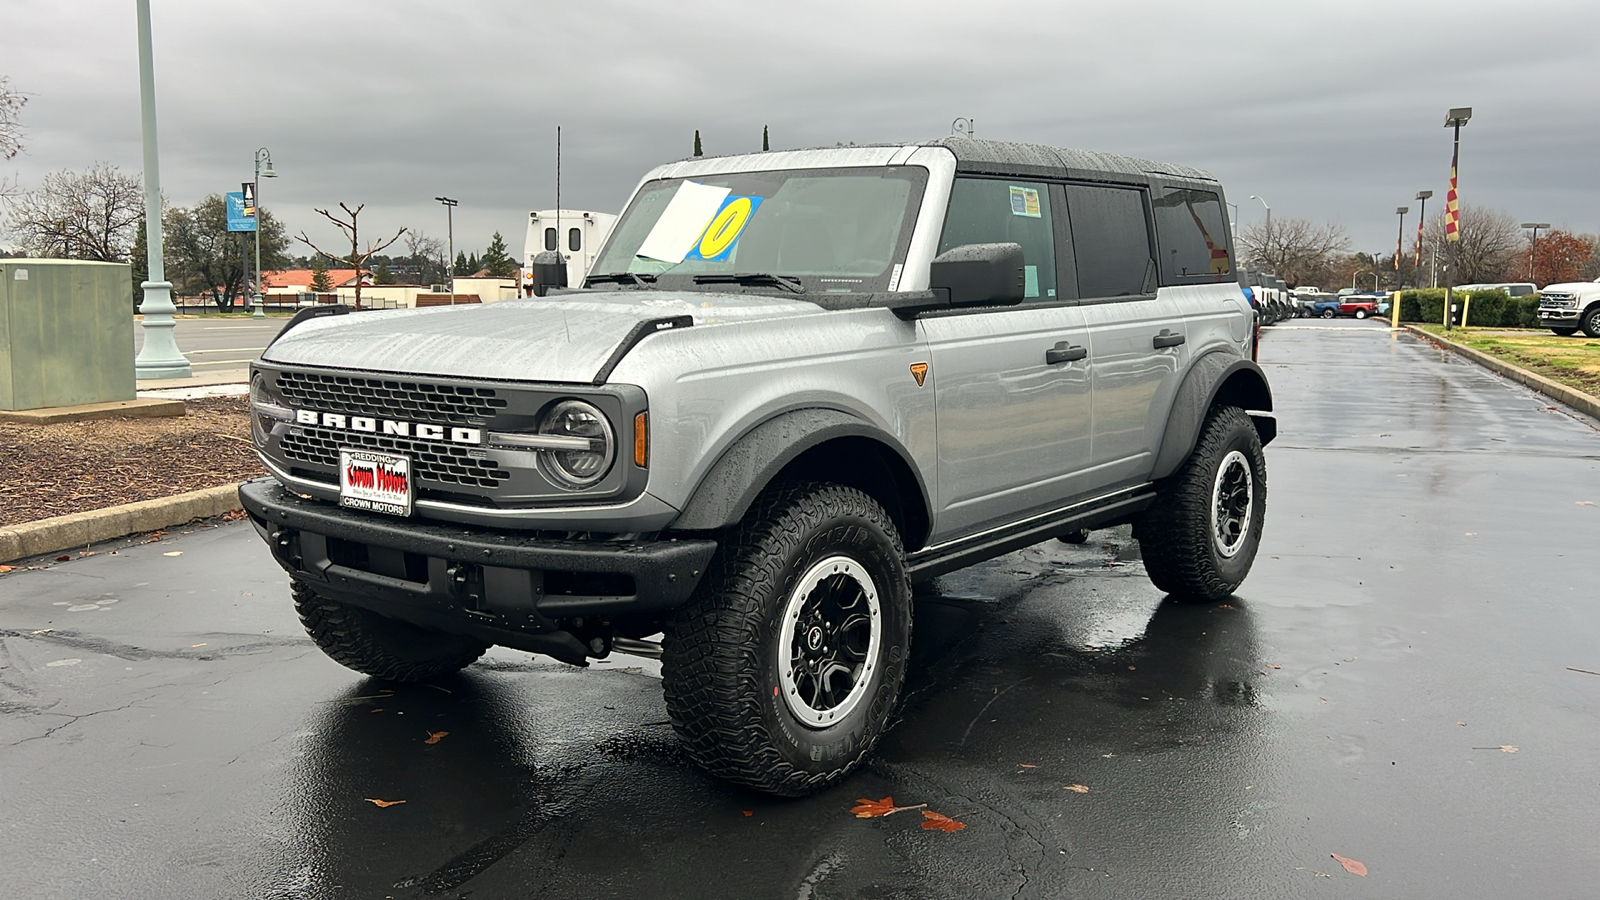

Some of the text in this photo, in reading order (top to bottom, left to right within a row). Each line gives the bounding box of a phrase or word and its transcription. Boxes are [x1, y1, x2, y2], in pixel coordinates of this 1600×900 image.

[297, 409, 480, 444] BRONCO
[355, 453, 391, 463] REDDING
[347, 462, 408, 495] Crown Motors
[344, 497, 404, 514] CROWN MOTORS
